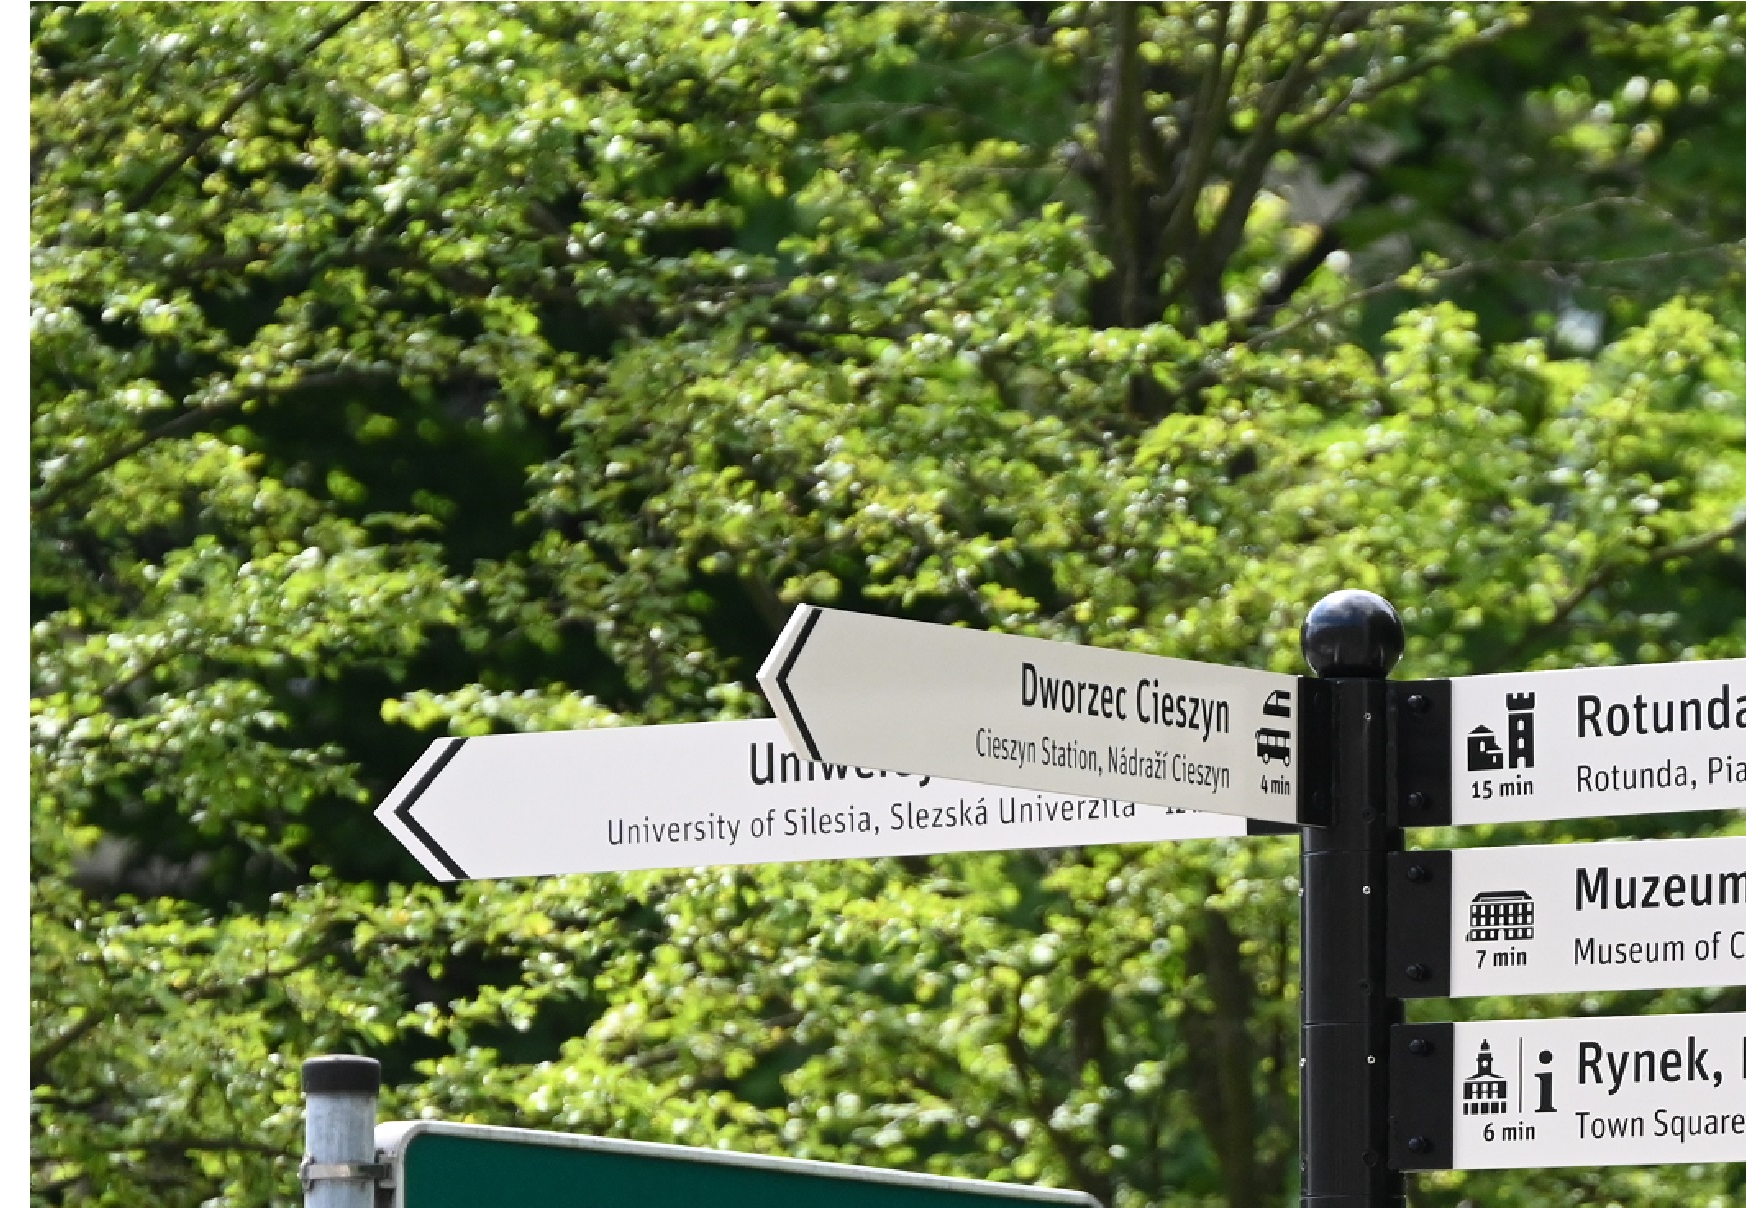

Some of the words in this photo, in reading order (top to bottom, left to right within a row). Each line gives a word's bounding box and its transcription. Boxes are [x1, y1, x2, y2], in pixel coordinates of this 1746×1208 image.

[1021, 662, 1128, 720] Dworzec
[1136, 677, 1230, 743] Cieszyn
[975, 727, 1036, 769] Cieszyn
[1041, 736, 1103, 776] Station,
[1108, 746, 1169, 779] Nádraží
[1172, 753, 1230, 795] Cieszyn
[1577, 758, 1697, 793] Rotunda,
[1259, 772, 1270, 796] 4
[1269, 774, 1292, 799] min
[1470, 778, 1492, 801] 15
[1496, 776, 1536, 799] min
[608, 812, 741, 846] University
[751, 808, 776, 839] of
[783, 805, 880, 836] Silesia,
[890, 797, 987, 831] Slezská
[1474, 948, 1488, 971] 7
[1490, 945, 1529, 969] min
[1574, 937, 1684, 965] Museum
[1695, 930, 1722, 961] of
[1579, 1035, 1723, 1096] Rynek,
[1482, 1122, 1496, 1143] 6
[1499, 1119, 1537, 1143] min
[1574, 1111, 1645, 1139] Town
